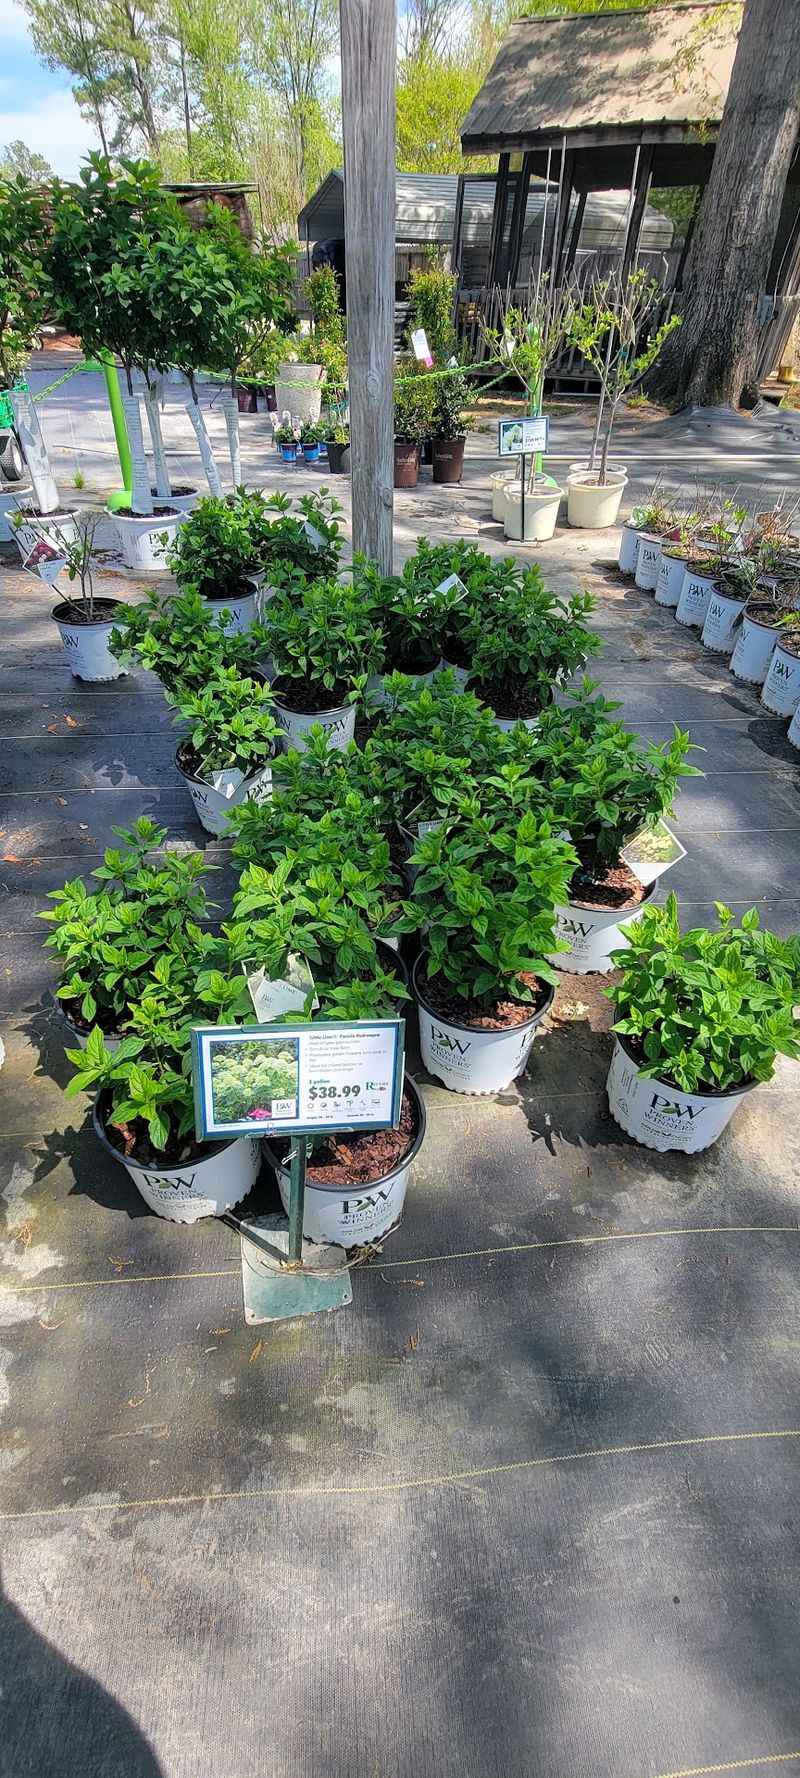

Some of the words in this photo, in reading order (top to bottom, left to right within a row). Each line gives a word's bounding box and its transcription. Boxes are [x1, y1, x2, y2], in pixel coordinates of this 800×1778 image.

[556, 914, 596, 937] PW
[430, 1023, 471, 1055] PW
[309, 1085, 361, 1100] $38.99
[649, 1093, 708, 1119] PW
[143, 1172, 197, 1191] PW
[340, 1182, 395, 1215] PW
